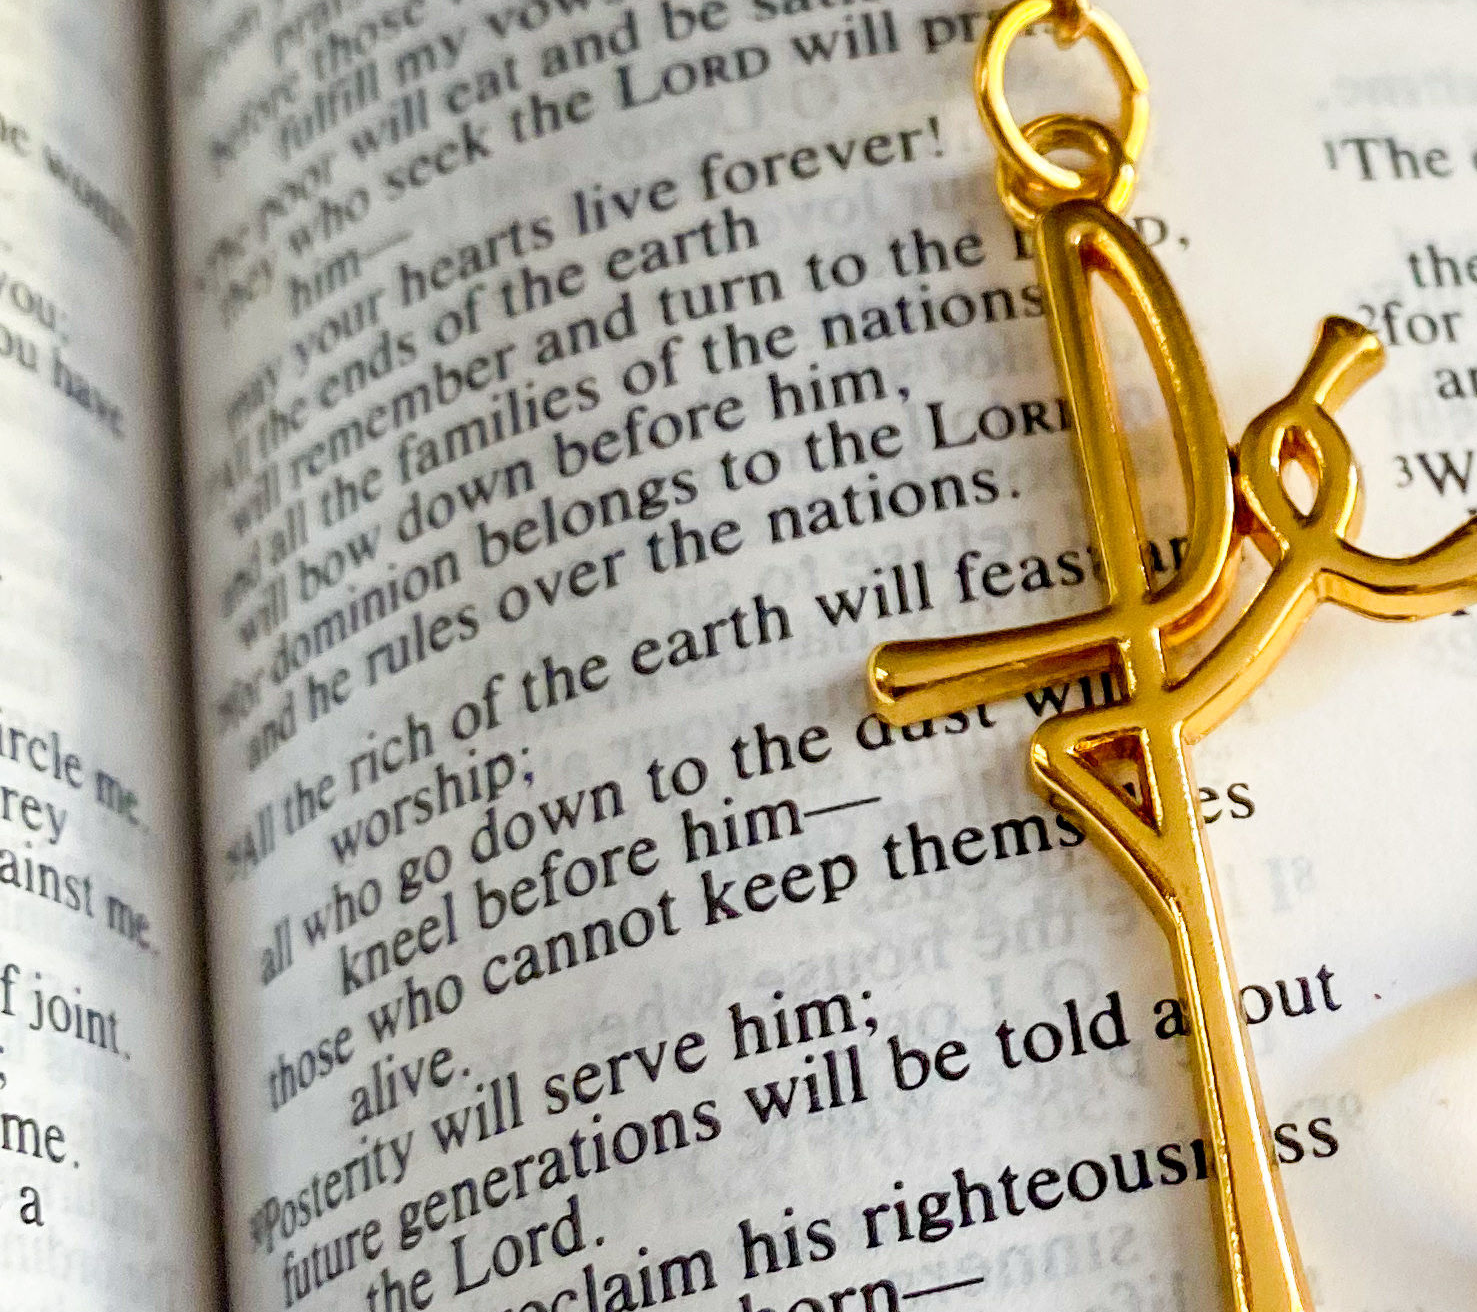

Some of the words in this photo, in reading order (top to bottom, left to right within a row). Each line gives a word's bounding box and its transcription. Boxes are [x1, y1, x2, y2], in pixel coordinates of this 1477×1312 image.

[606, 207, 758, 281] earth
[658, 270, 782, 326] turn
[806, 254, 866, 292] to
[889, 228, 984, 277] the
[553, 397, 744, 477] before
[767, 361, 909, 419] him,
[623, 336, 682, 395] of
[702, 324, 794, 374] the
[477, 470, 697, 567] belongs
[720, 450, 780, 491] to
[805, 420, 902, 472] the
[498, 549, 625, 622] over
[646, 519, 742, 573] the
[767, 469, 1020, 544] nations.
[451, 674, 504, 740] of
[521, 655, 609, 713] the
[631, 594, 792, 676] earth
[815, 560, 933, 627] will
[471, 781, 624, 864] down
[647, 757, 707, 803] to
[730, 723, 831, 780] the
[368, 975, 463, 1043] who
[483, 891, 680, 995] cannot
[701, 854, 857, 926] keep
[474, 838, 659, 930] before
[399, 1100, 721, 1251] generations
[744, 1045, 868, 1124] will
[887, 1035, 970, 1091] be
[995, 990, 1131, 1069] told
[431, 1072, 523, 1153] will
[544, 1032, 706, 1115] serve
[728, 990, 877, 1060] him;
[450, 1194, 604, 1295] Lord.
[738, 1208, 836, 1280] his
[862, 1117, 1340, 1250] righteousss
